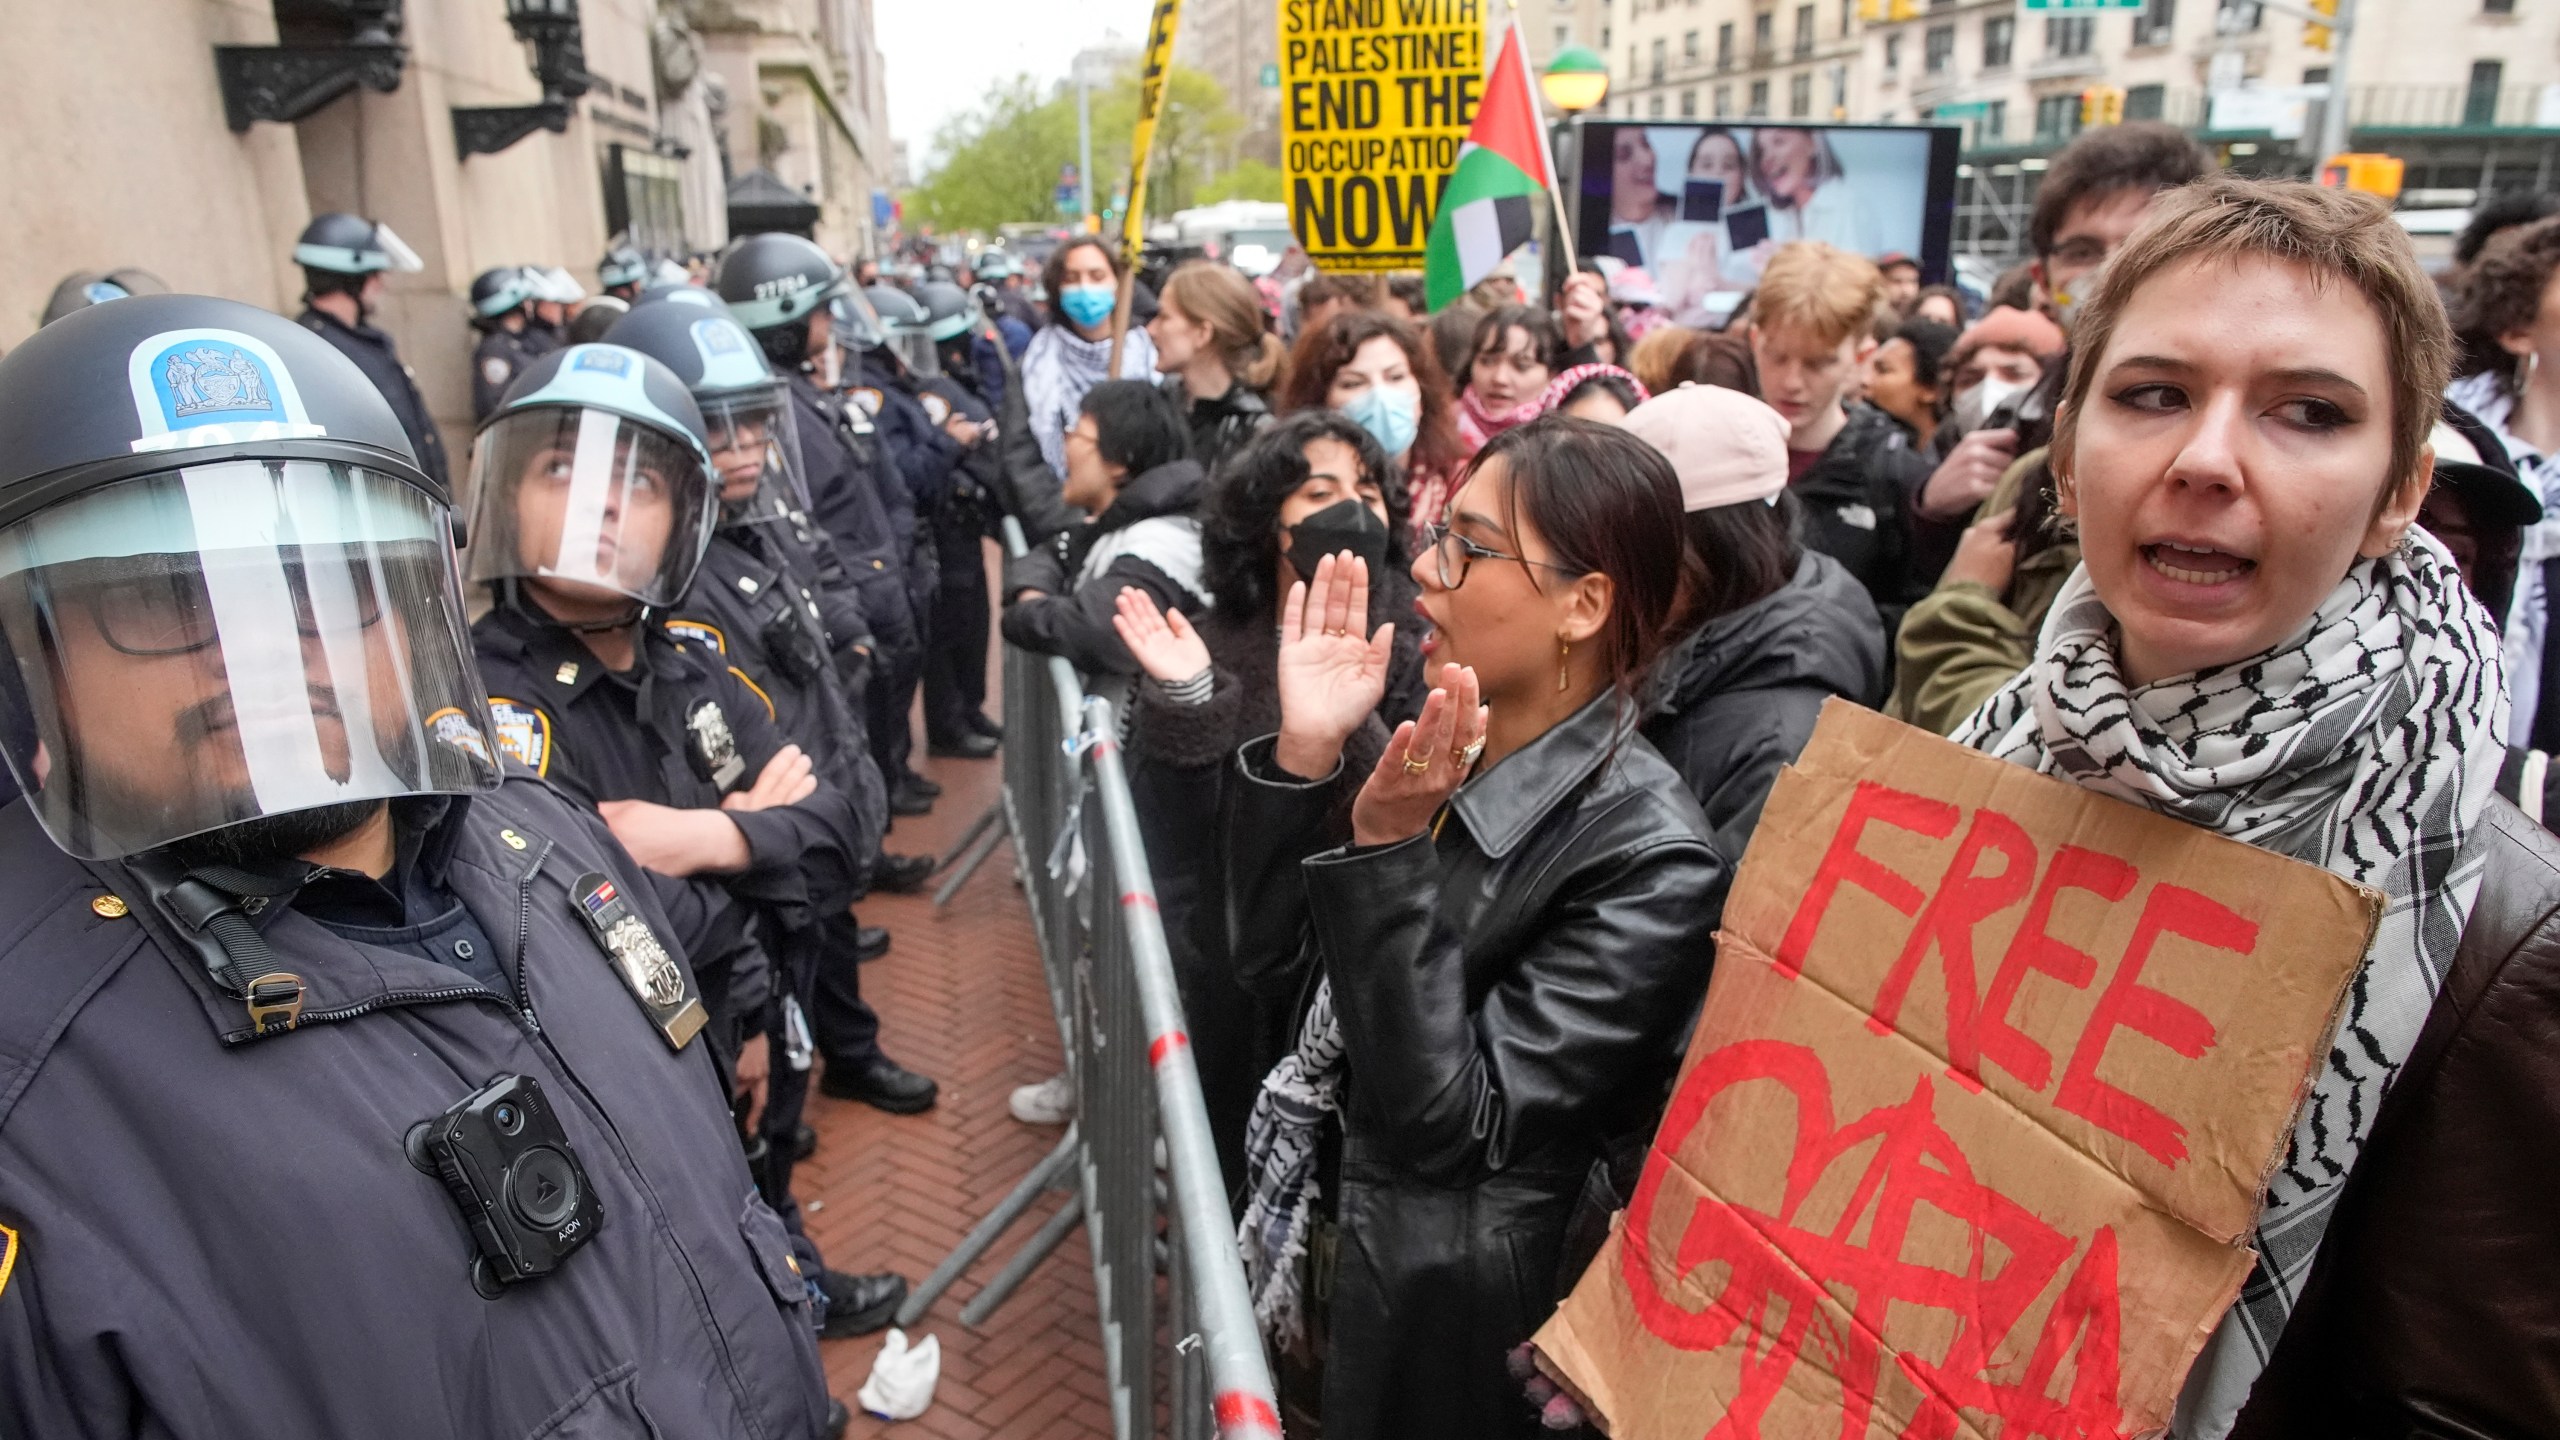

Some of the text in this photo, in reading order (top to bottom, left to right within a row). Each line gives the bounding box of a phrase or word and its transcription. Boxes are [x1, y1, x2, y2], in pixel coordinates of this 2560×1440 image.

[1286, 0, 1478, 33] STAND WITH
[1288, 31, 1479, 75] PALESTINE!
[1291, 74, 1481, 131] END THE
[1293, 174, 1451, 248] NOW
[1771, 779, 2259, 1171] FREE
[558, 1218, 581, 1242] AXON
